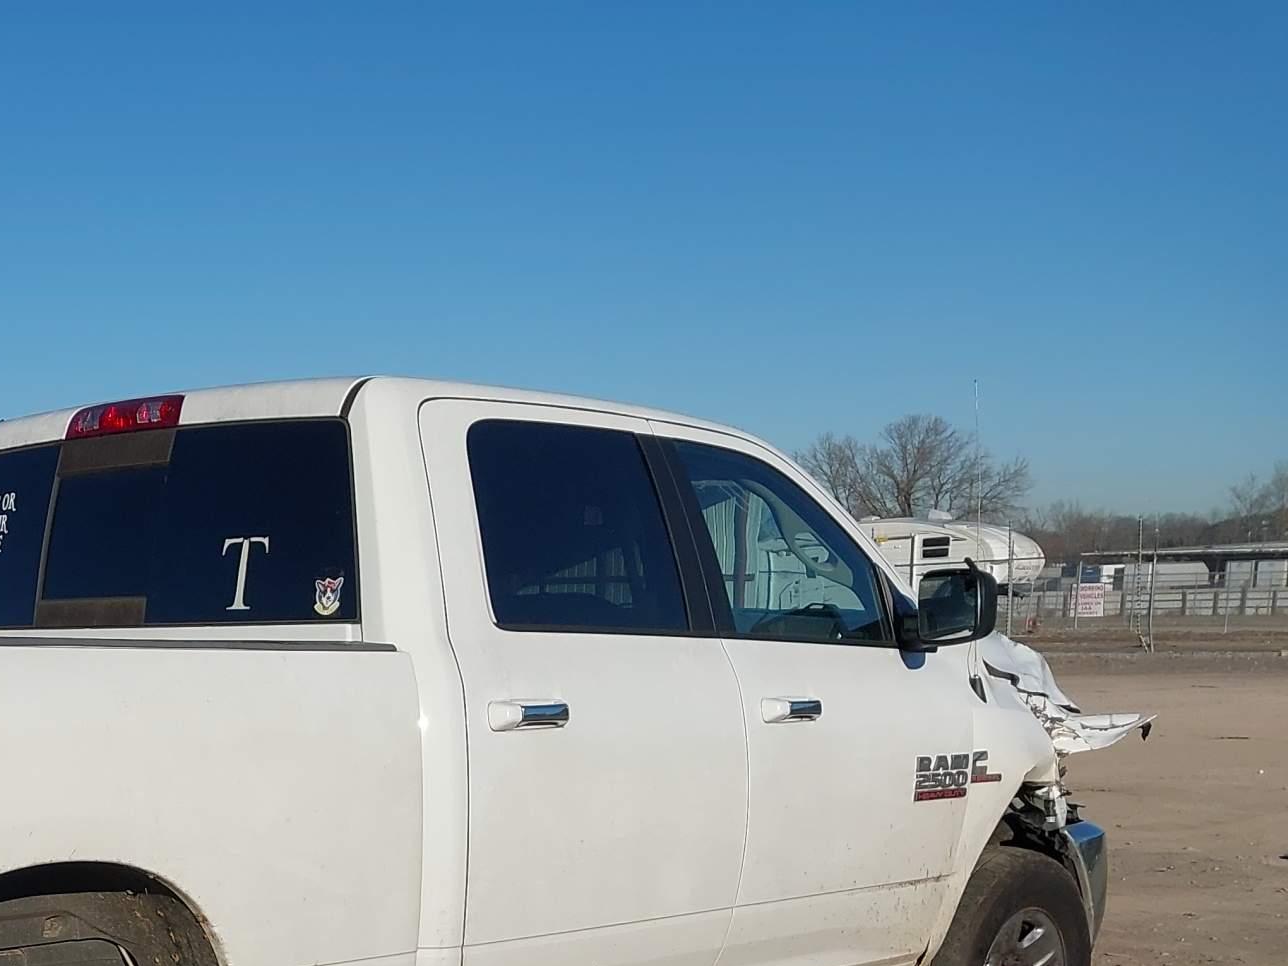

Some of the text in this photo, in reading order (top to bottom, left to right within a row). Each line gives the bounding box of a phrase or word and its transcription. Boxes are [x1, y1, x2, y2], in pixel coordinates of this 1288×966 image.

[2, 492, 16, 511] OR
[222, 535, 269, 610] T
[916, 753, 970, 772] RAM
[915, 771, 969, 790] 2500
